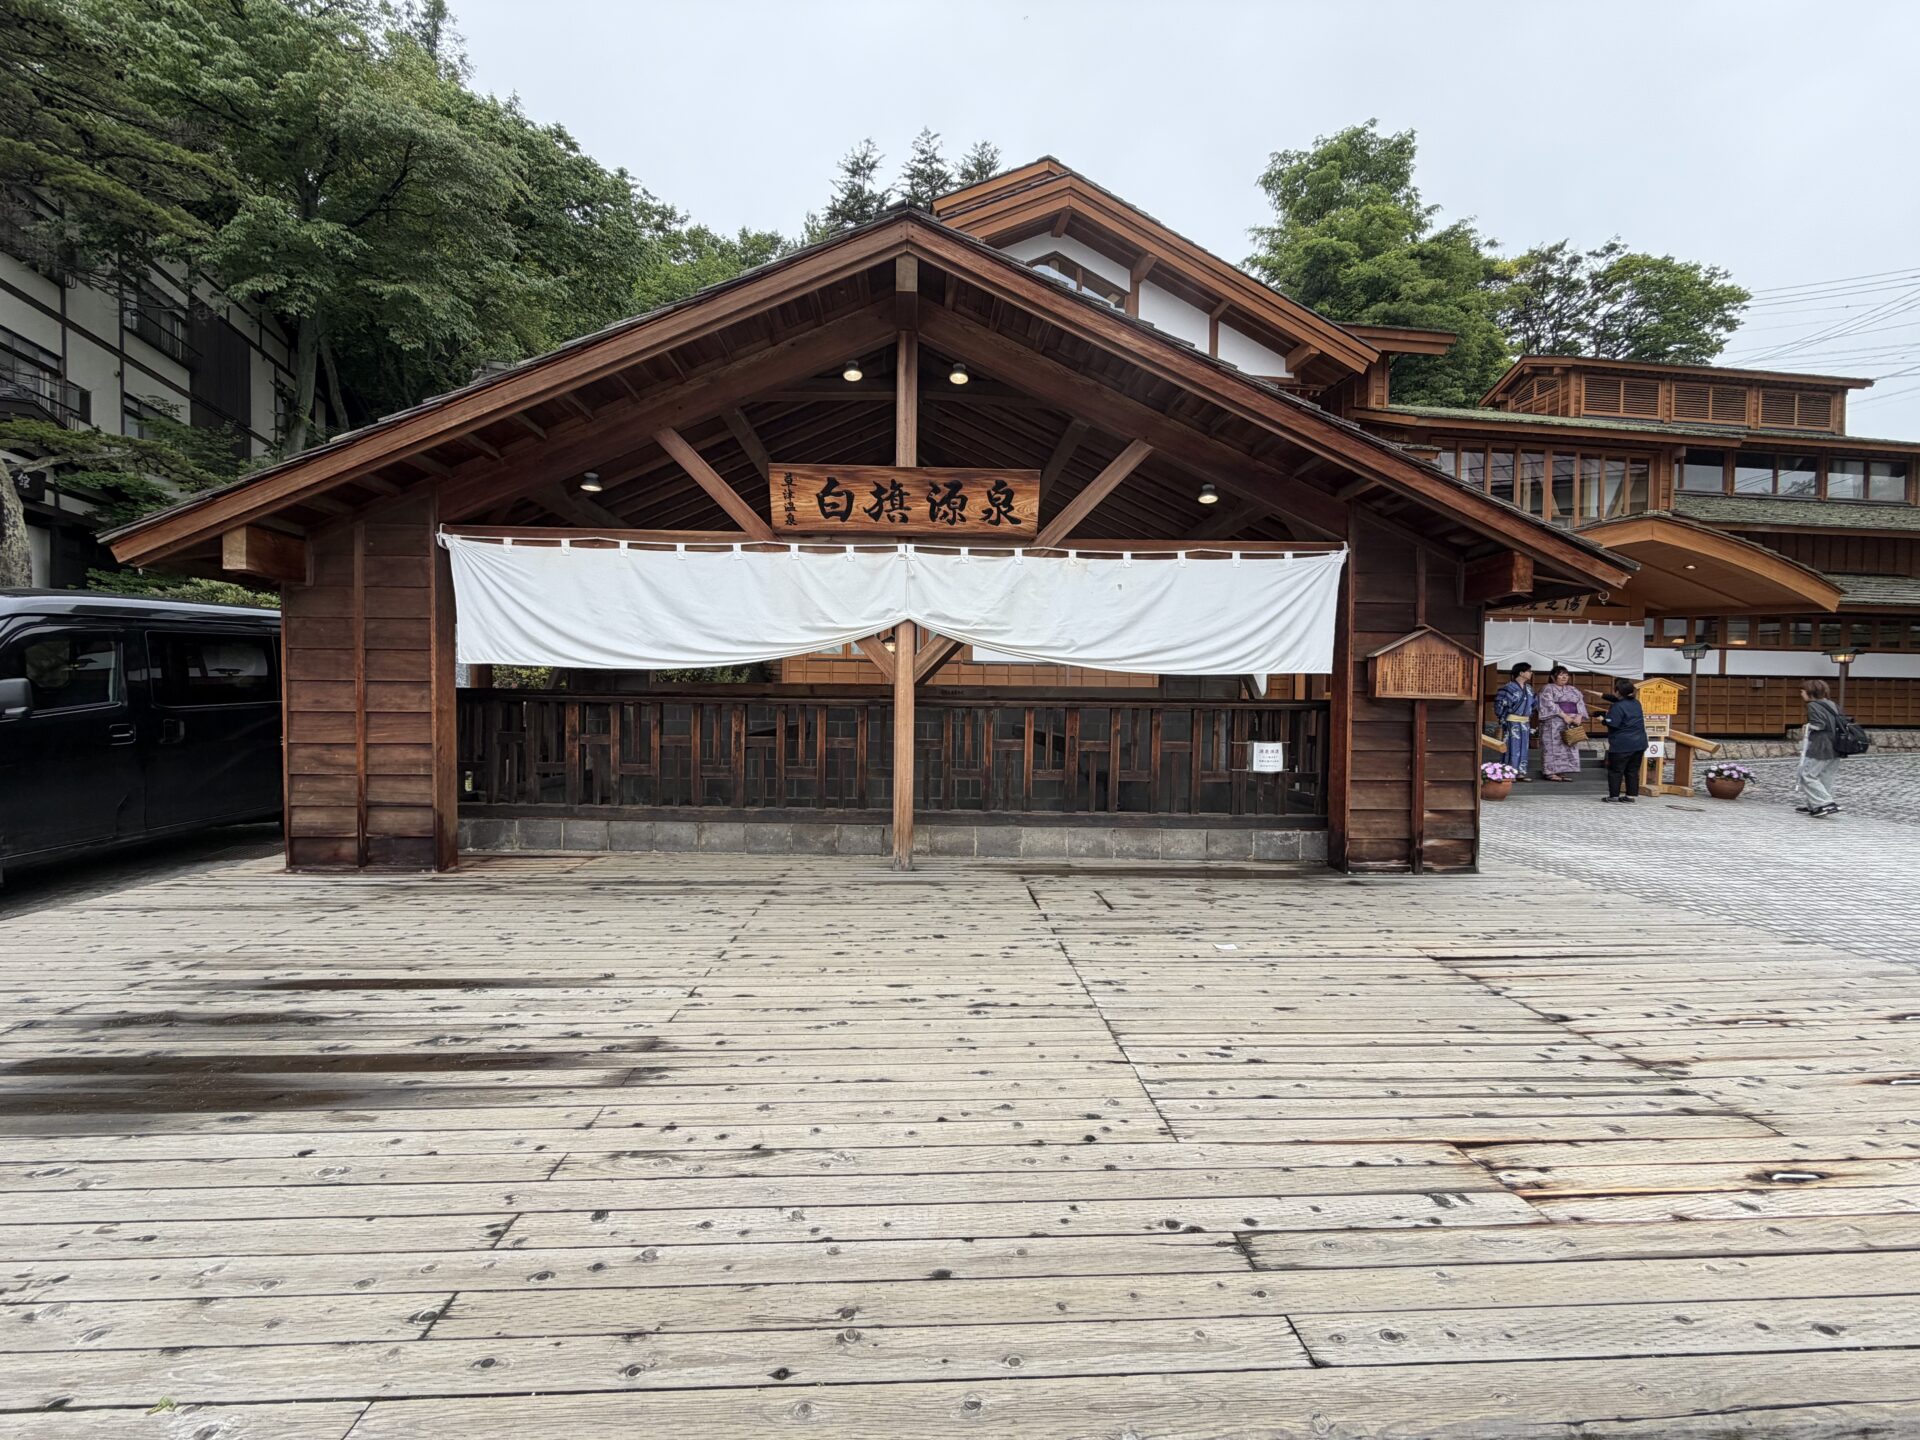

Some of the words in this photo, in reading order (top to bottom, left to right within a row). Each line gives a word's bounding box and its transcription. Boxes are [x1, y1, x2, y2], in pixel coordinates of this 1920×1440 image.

[815, 476, 1022, 527] 白旗源泉
[1590, 642, 1606, 659] 座
